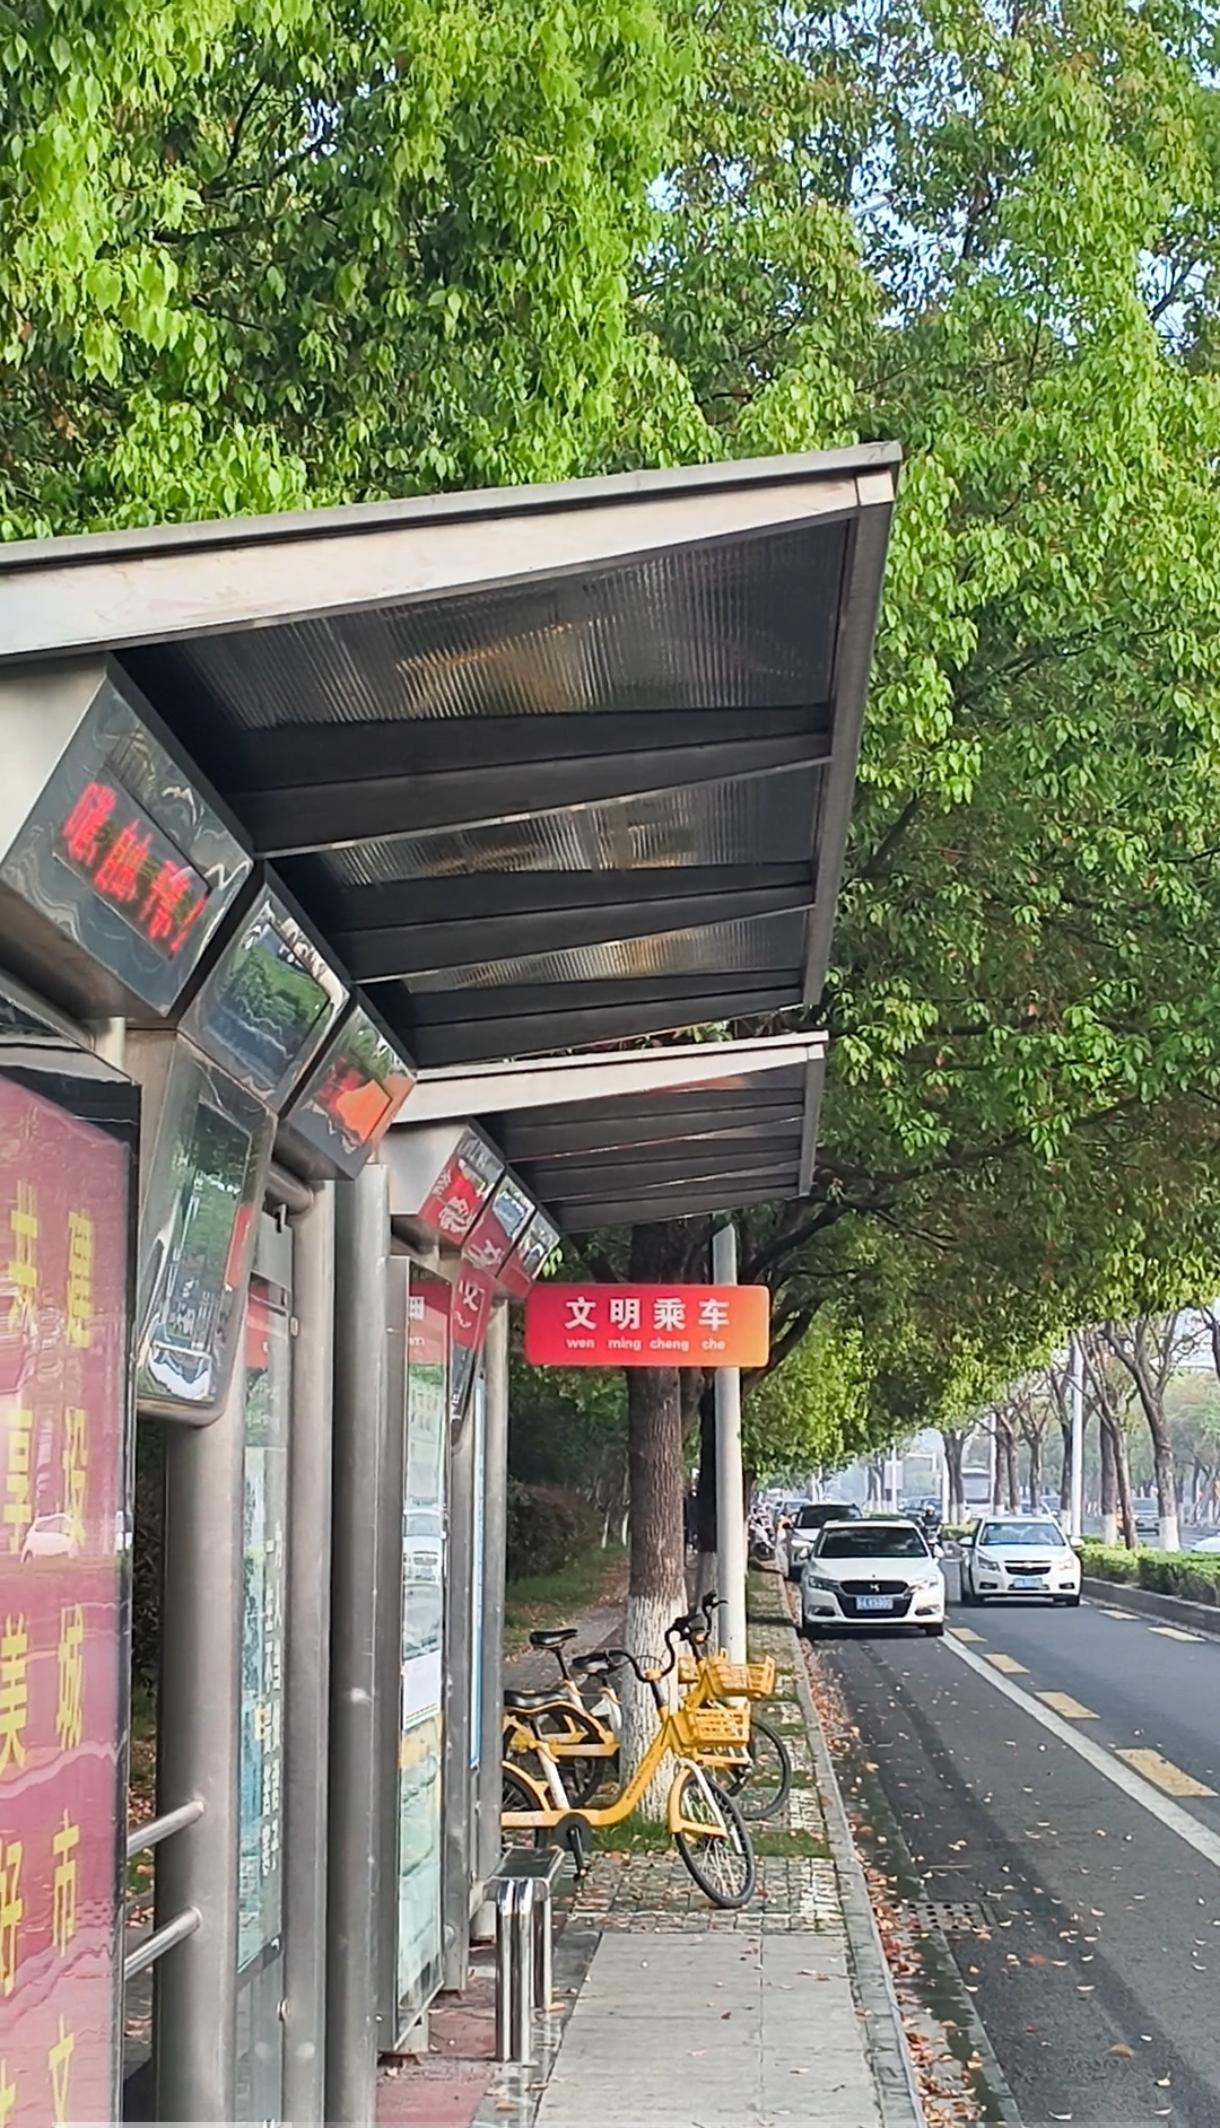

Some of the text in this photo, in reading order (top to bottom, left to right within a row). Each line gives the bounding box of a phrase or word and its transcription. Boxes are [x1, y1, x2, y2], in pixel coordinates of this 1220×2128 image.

[564, 1296, 730, 1331] 文明乘车
[566, 1337, 726, 1352] wen ming cheng che
